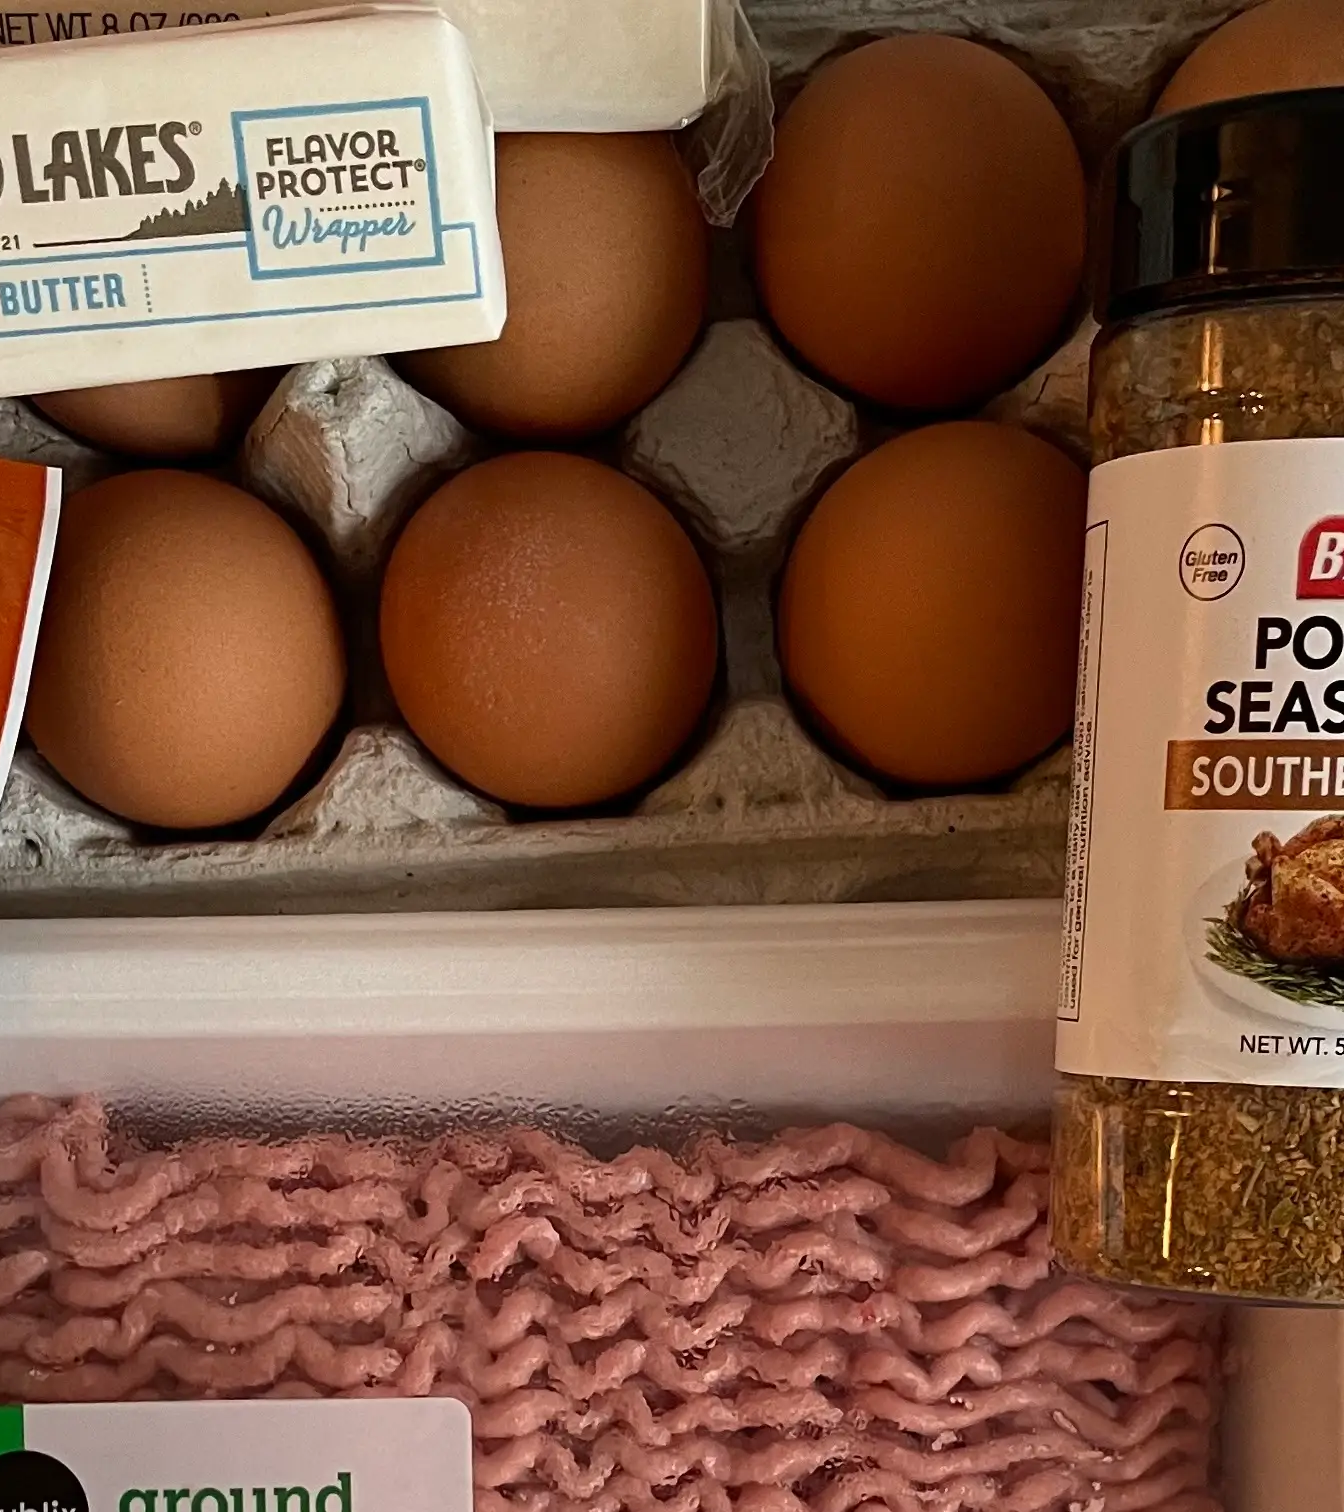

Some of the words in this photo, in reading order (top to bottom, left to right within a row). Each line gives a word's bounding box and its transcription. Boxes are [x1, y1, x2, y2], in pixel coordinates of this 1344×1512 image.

[12, 122, 196, 204] LAKES
[266, 130, 400, 167] FLAVOR
[256, 160, 413, 200] PROTECT
[262, 204, 416, 254] Wrapper
[0, 272, 126, 317] BUTTER
[1185, 550, 1238, 566] Gluten
[1192, 567, 1228, 583] Free
[1240, 1035, 1284, 1054] NET
[1288, 1036, 1329, 1056] WT.
